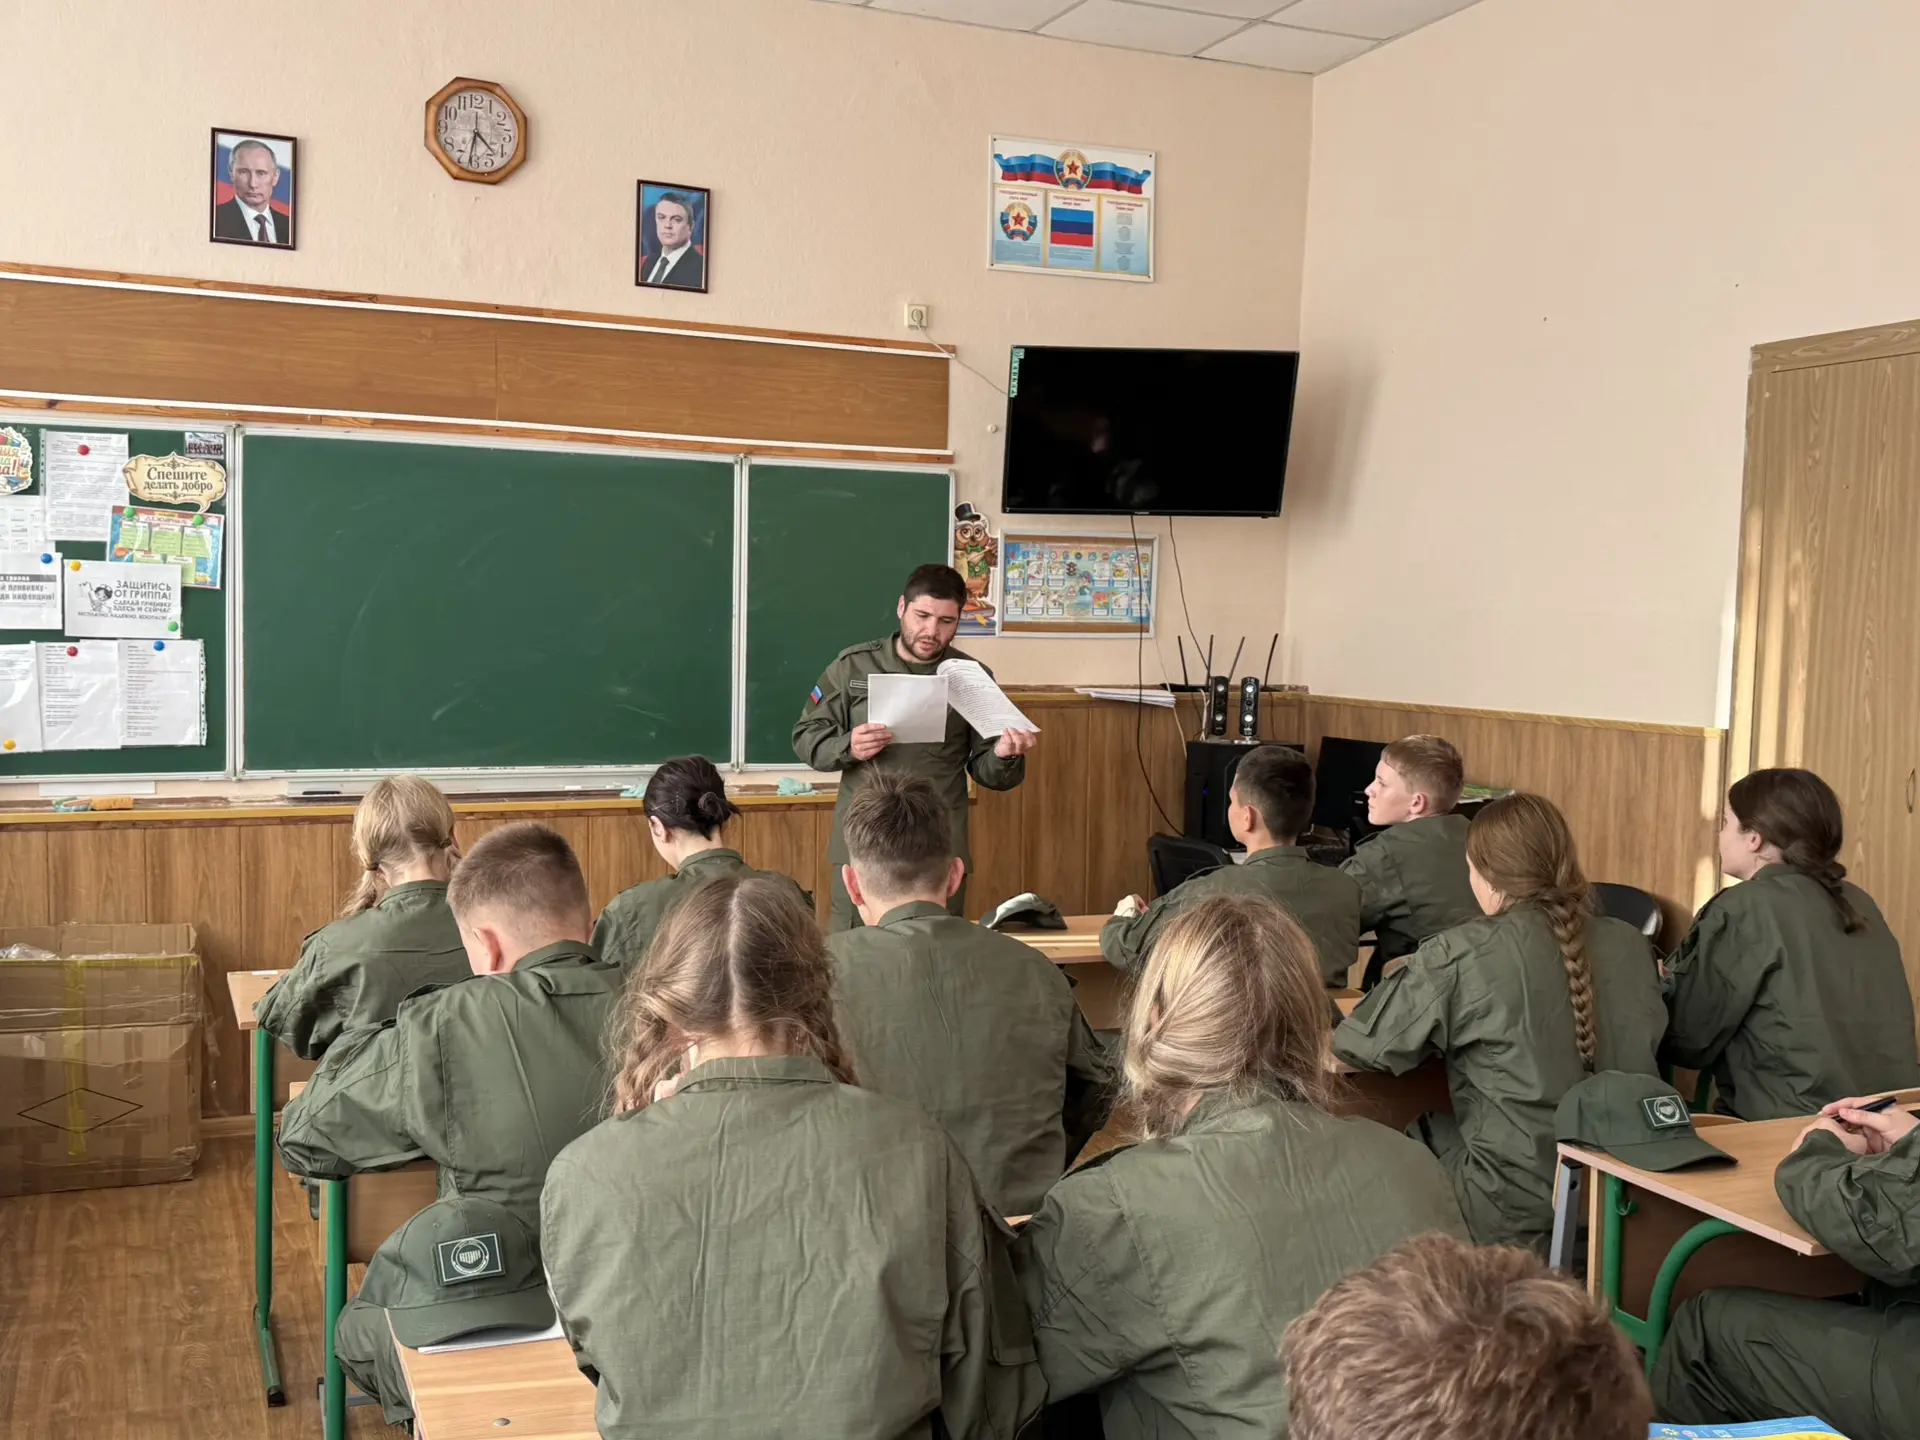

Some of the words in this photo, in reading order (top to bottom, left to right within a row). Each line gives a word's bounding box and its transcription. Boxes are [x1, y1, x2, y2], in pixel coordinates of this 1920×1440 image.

[458, 95, 467, 111] 11
[470, 94, 484, 109] 12
[489, 99, 493, 115] 1
[444, 105, 458, 121] 10
[496, 111, 507, 127] 2
[437, 119, 448, 135] 9
[503, 128, 512, 144] 3
[443, 136, 454, 152] 8
[457, 149, 466, 164] 7
[485, 153, 494, 168] 5
[147, 466, 207, 481] Спешите
[143, 481, 179, 491] делать
[181, 480, 213, 493] добро
[116, 580, 172, 591] ЗАЩИТИСЬ
[114, 589, 128, 597] ОТ
[130, 590, 171, 600] ГРИППА!
